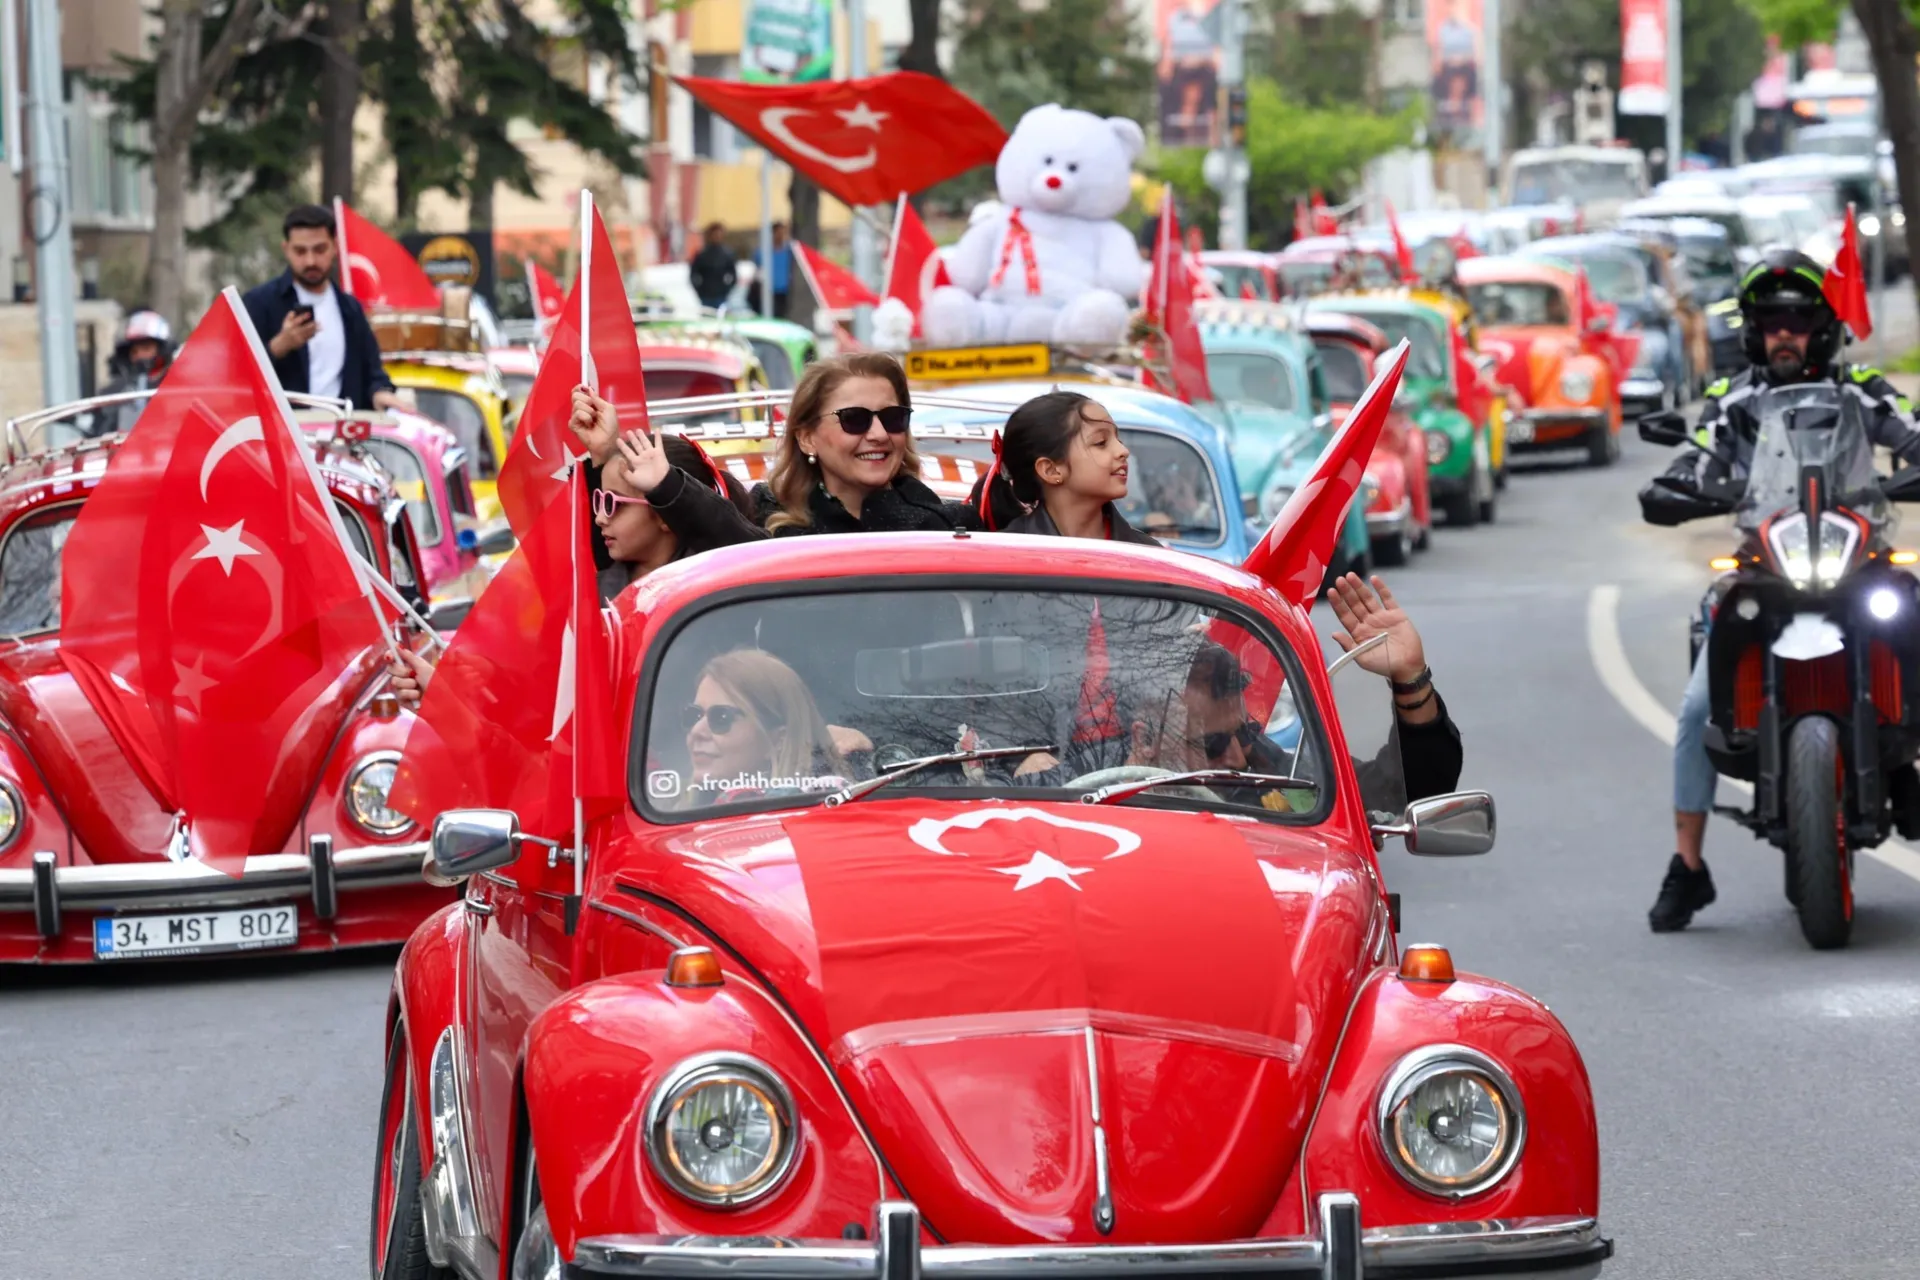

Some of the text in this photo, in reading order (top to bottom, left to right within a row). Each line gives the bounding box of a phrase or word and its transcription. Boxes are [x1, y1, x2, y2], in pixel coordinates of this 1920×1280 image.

[116, 921, 148, 947] 34
[168, 917, 219, 944] MST
[240, 911, 290, 937] 802
[99, 938, 113, 949] TR
